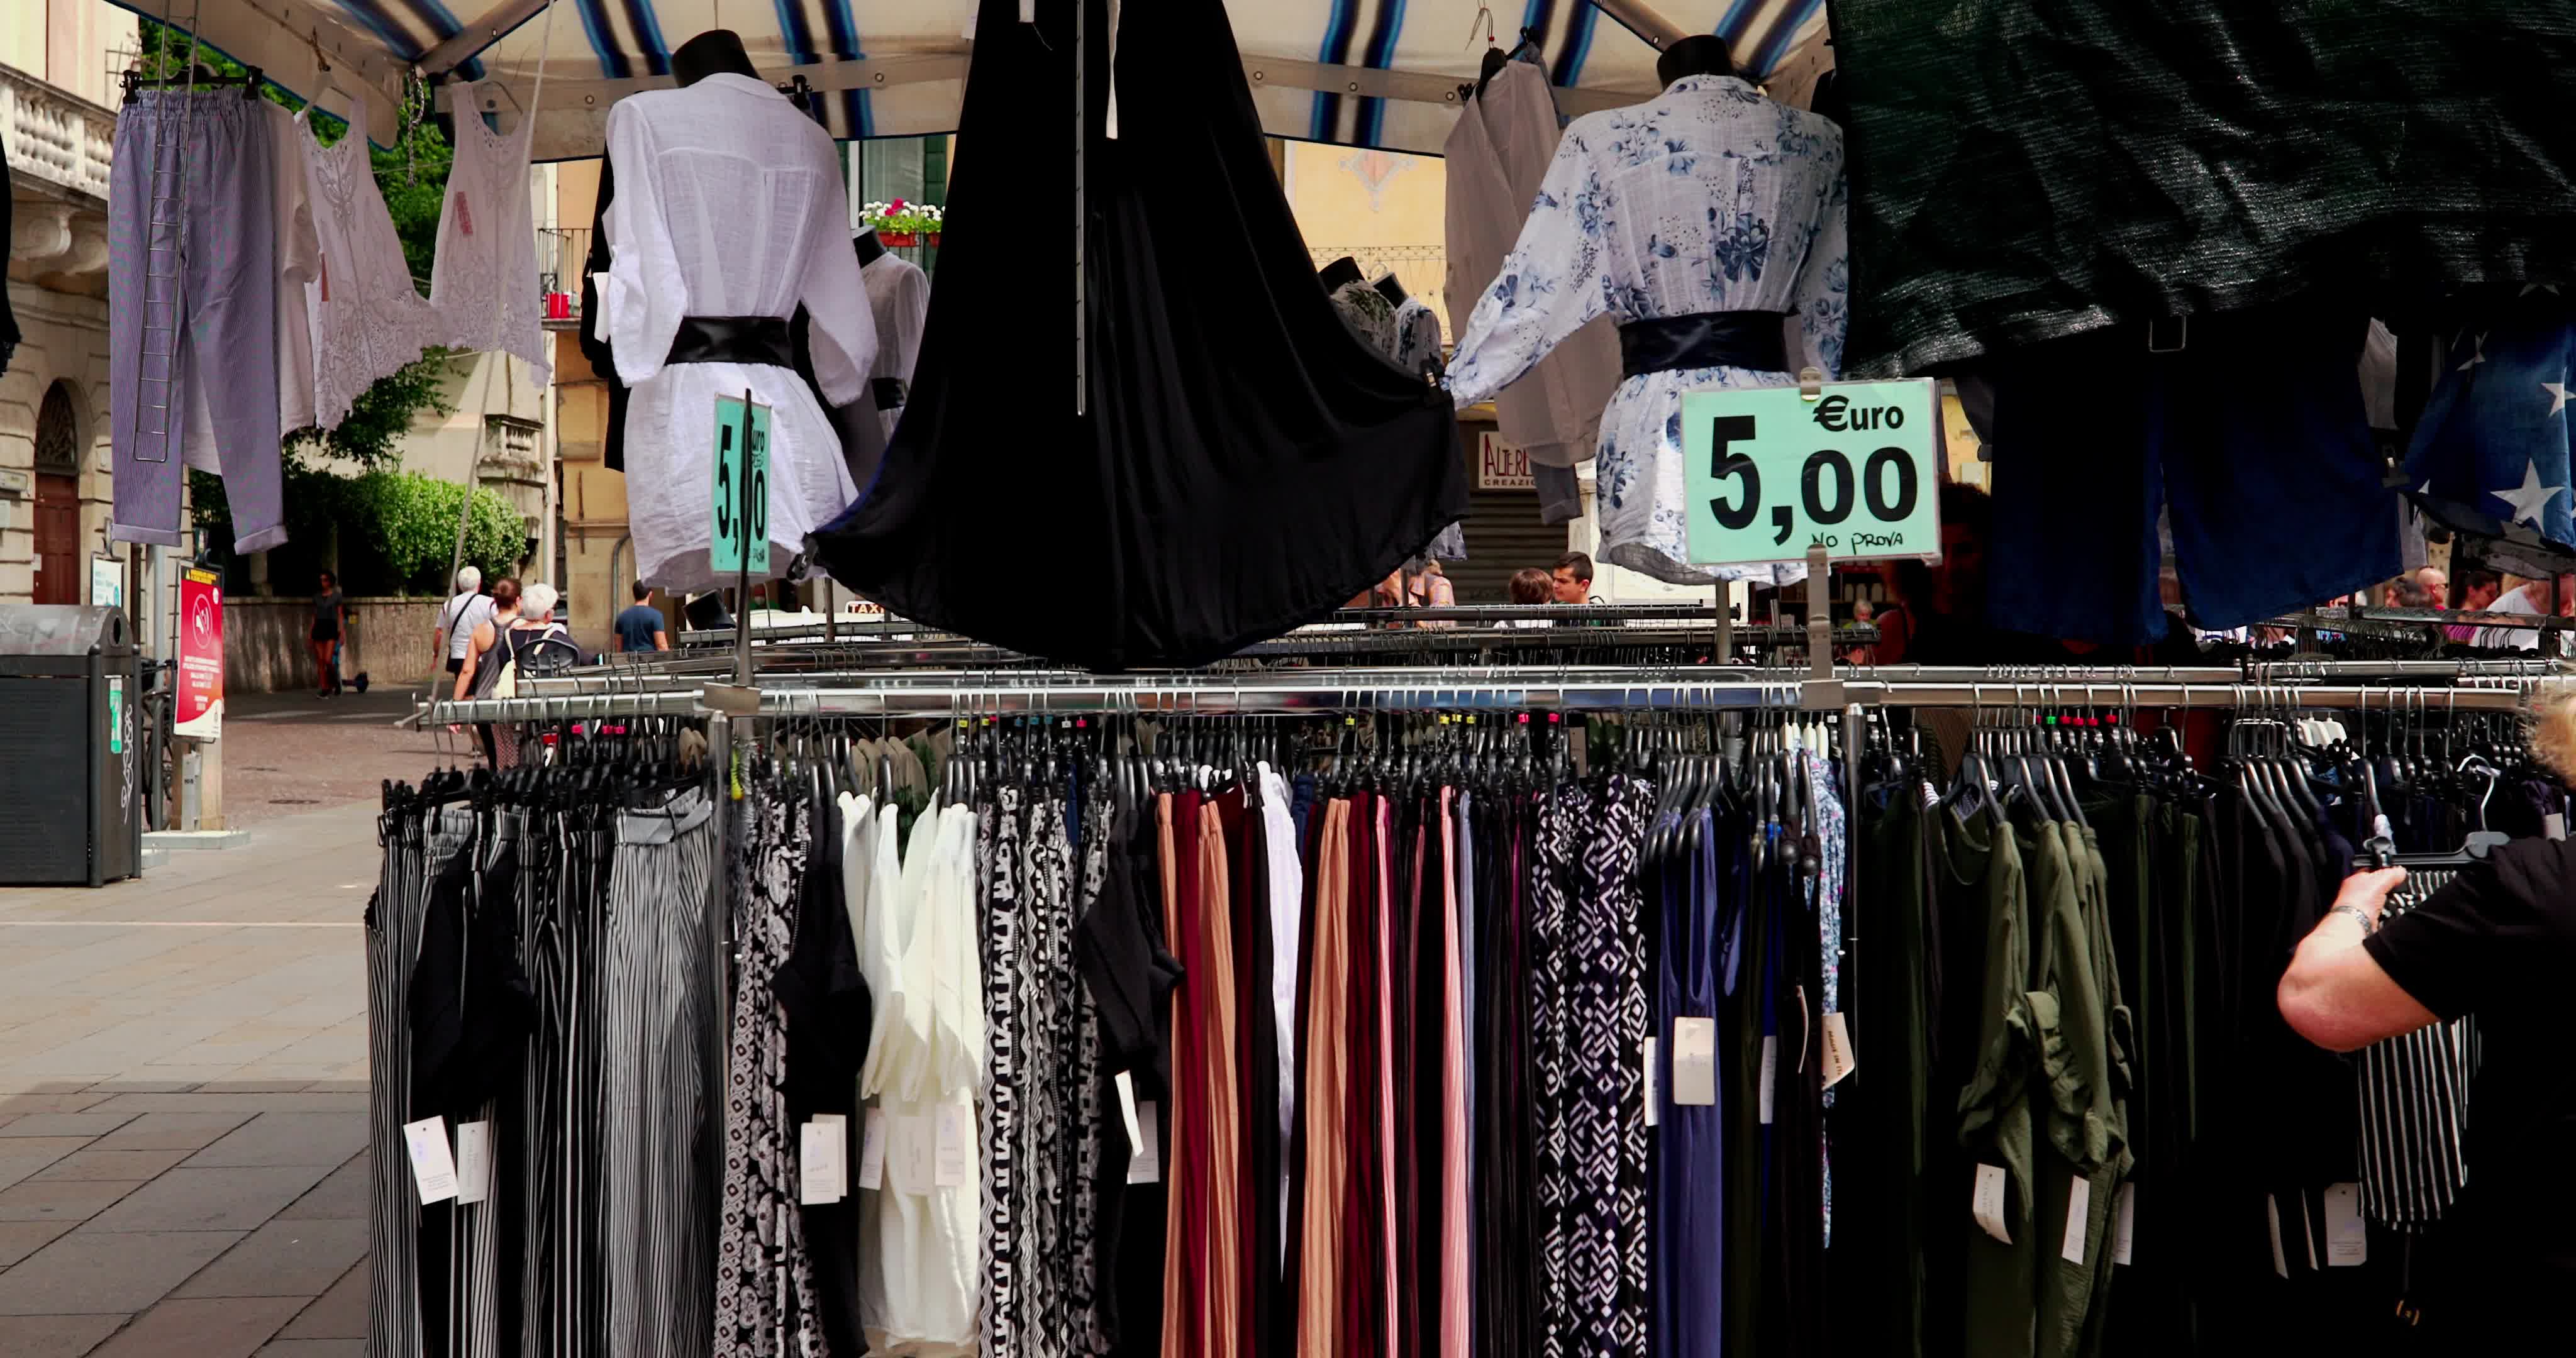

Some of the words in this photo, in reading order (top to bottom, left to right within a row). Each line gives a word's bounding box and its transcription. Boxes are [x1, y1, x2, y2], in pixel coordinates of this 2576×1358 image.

[1709, 415, 1918, 546] 5,00
[1811, 531, 1838, 548] NO
[1851, 531, 1902, 555] PROVA
[849, 603, 884, 614] TAXI
